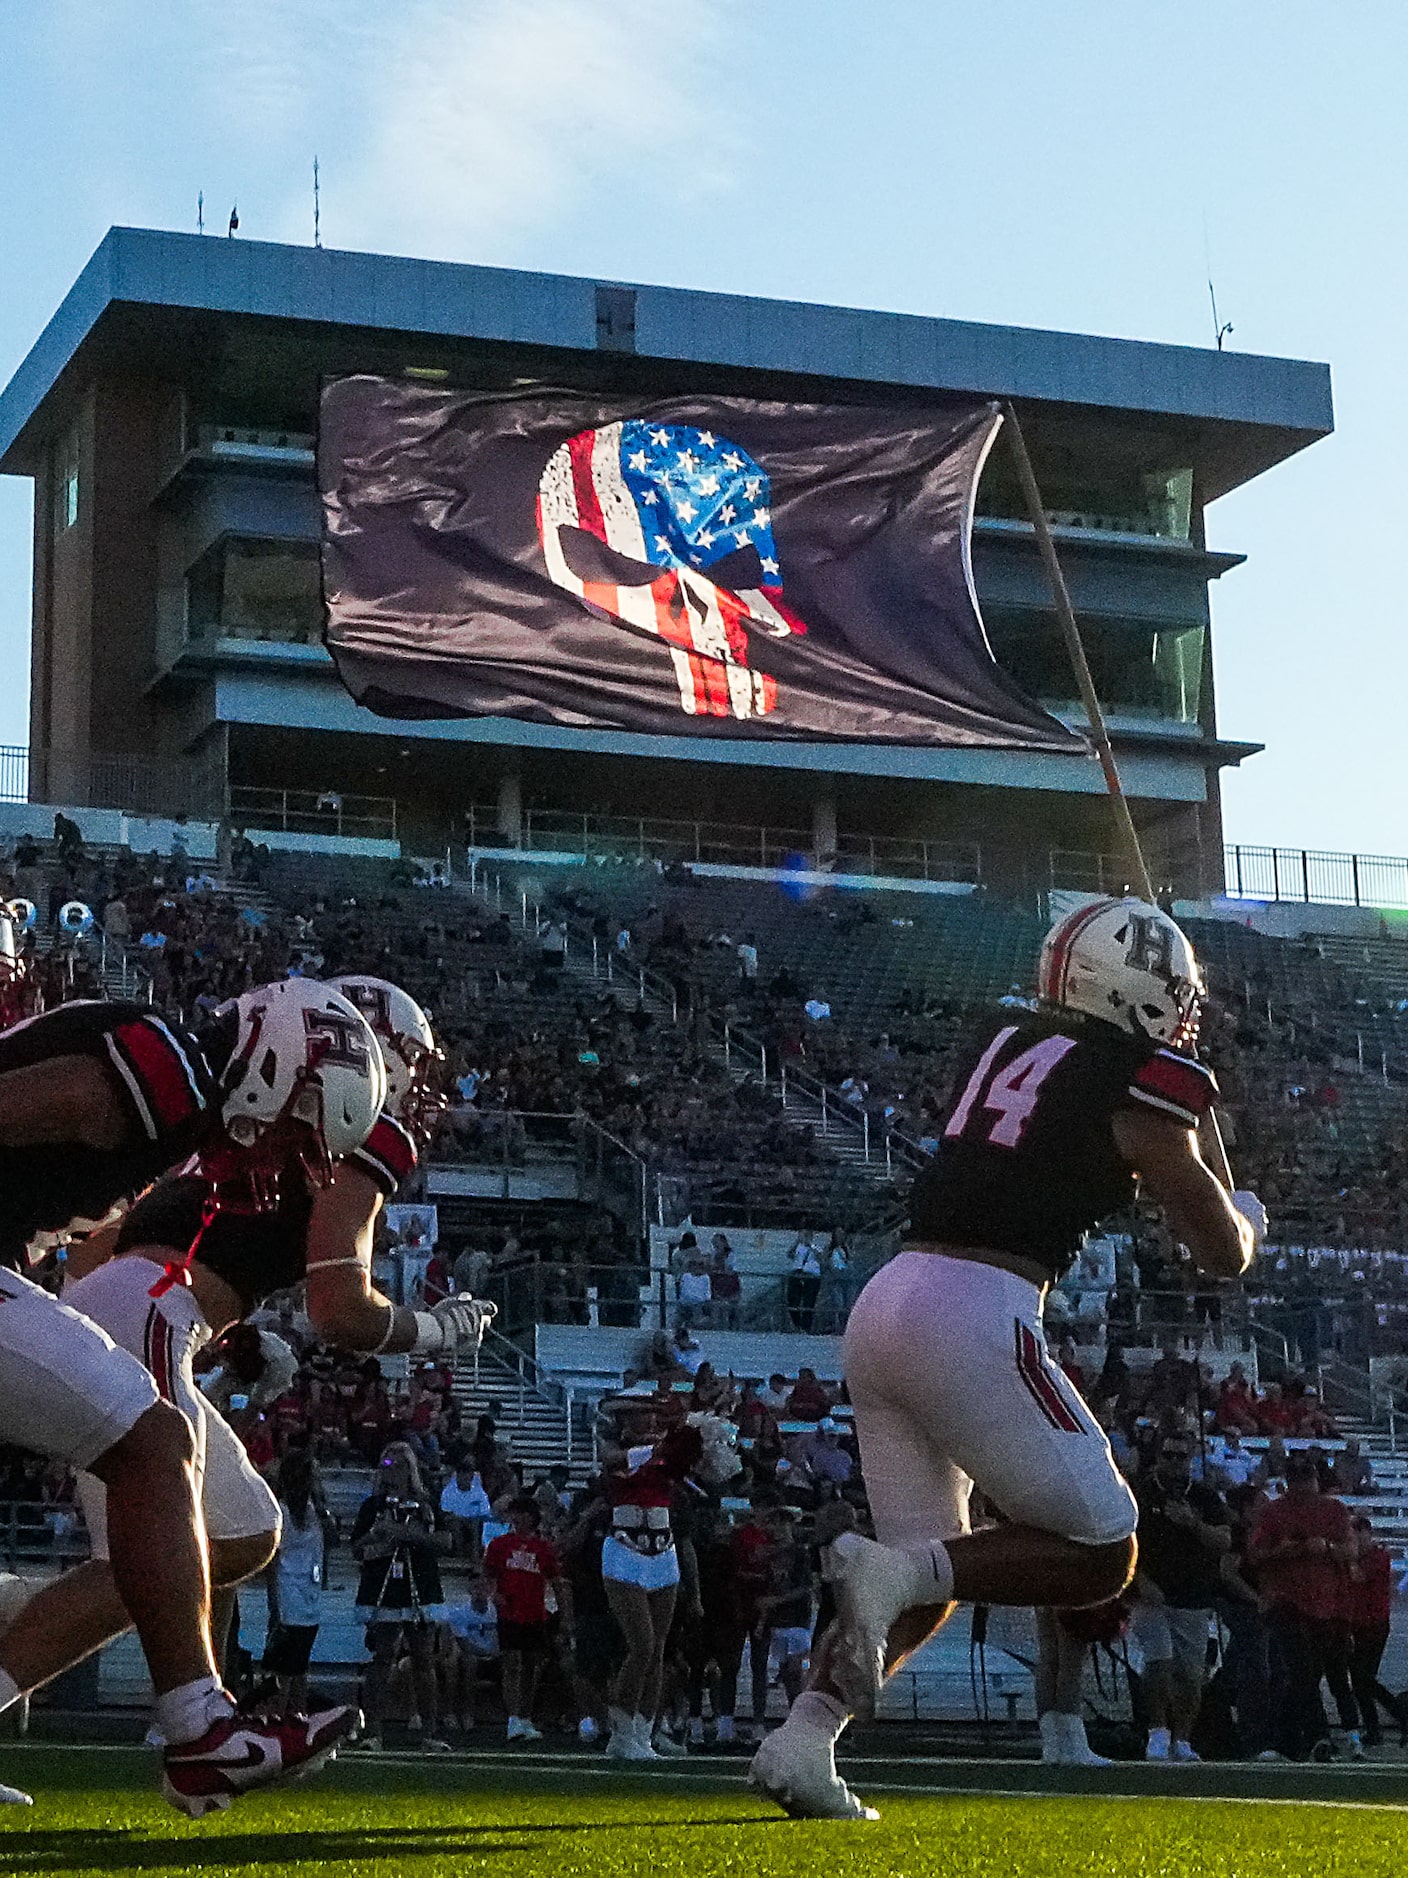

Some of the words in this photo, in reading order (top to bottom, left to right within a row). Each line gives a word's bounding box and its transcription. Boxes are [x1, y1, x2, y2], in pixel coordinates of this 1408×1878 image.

[1124, 911, 1174, 980] H
[302, 1008, 370, 1078] H
[944, 1026, 1078, 1147] 14
